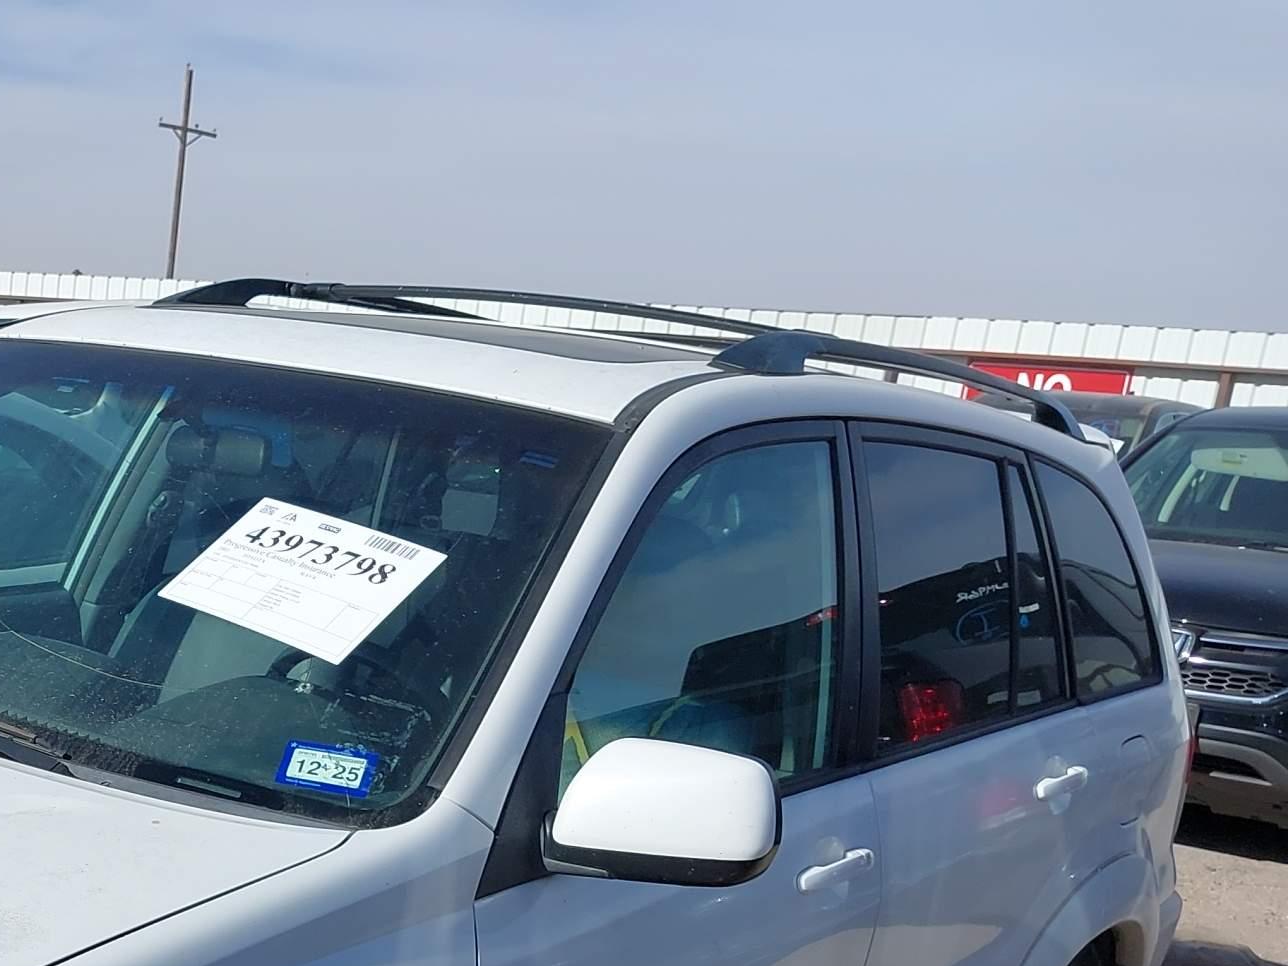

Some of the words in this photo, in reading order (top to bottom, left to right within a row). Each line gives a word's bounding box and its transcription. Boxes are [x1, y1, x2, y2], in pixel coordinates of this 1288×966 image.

[244, 525, 398, 585] 43973798
[296, 758, 322, 776] 12
[331, 764, 361, 782] 25
